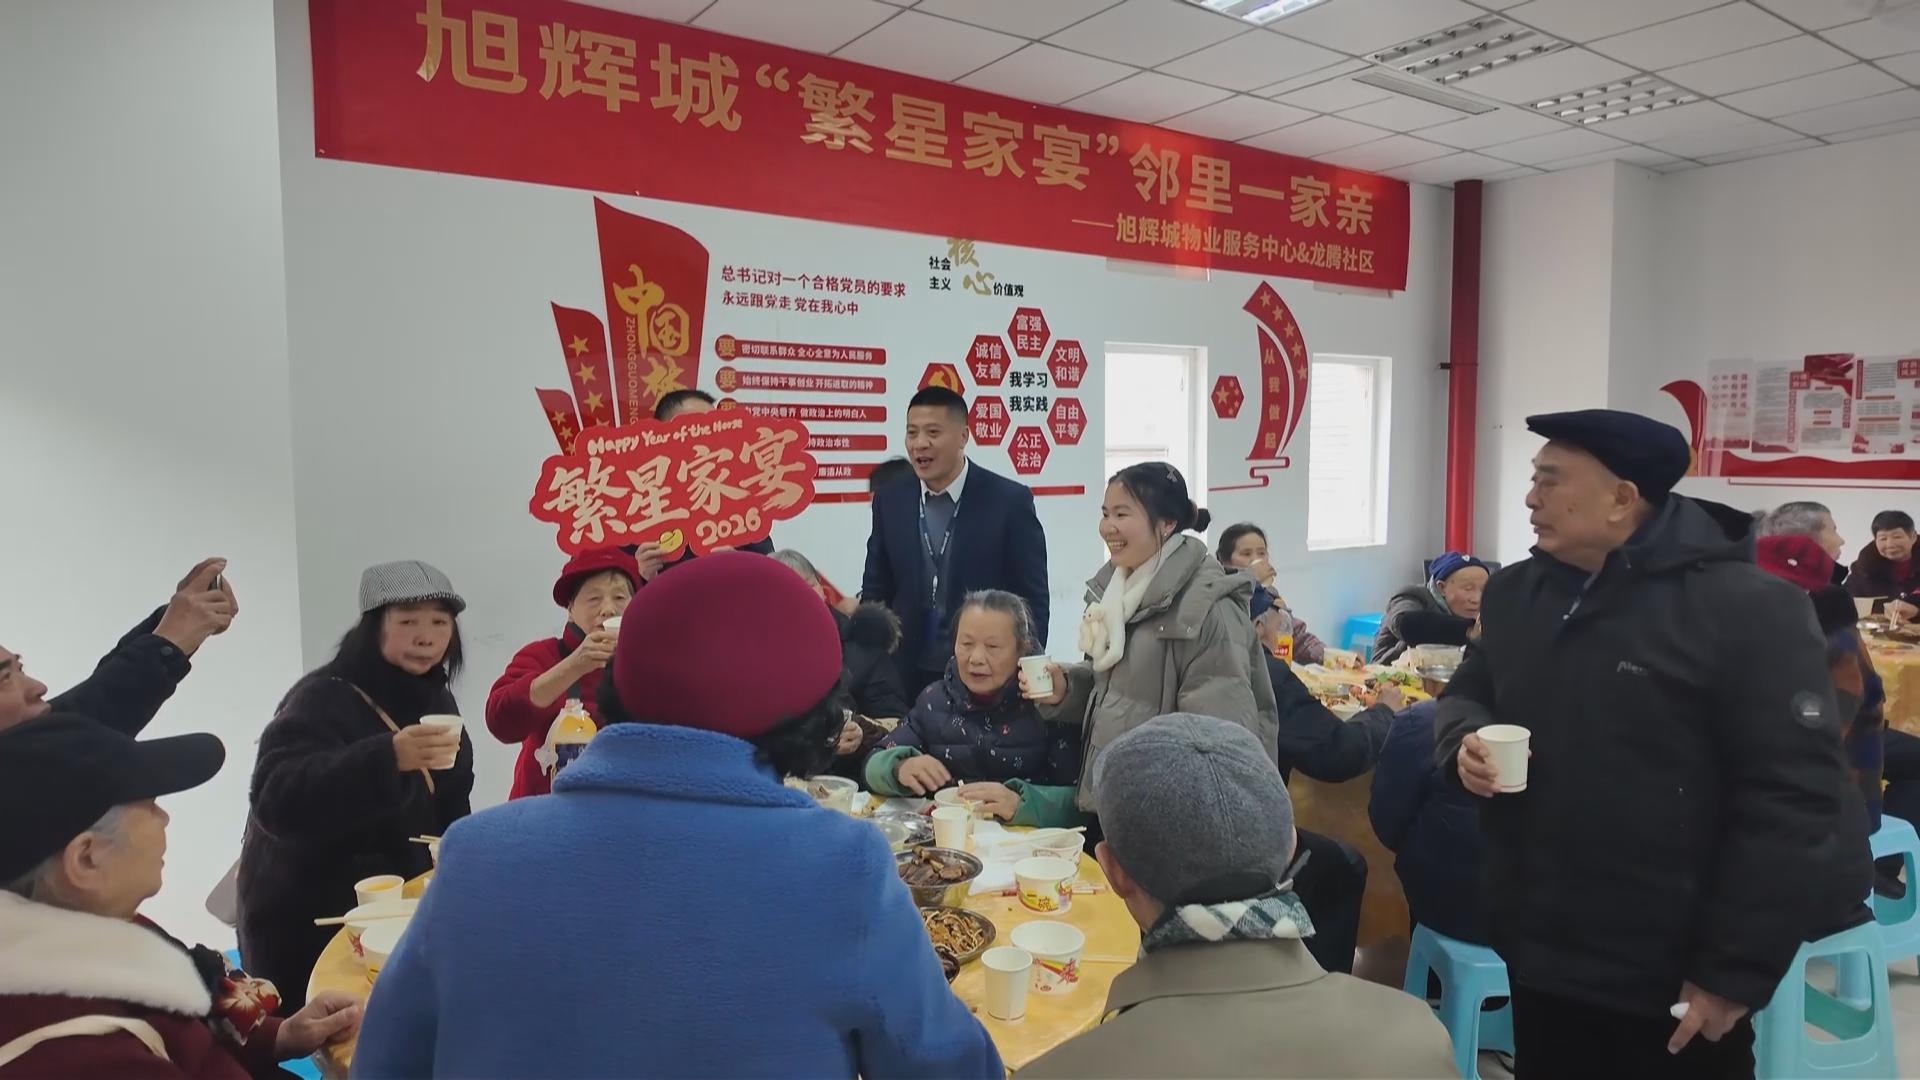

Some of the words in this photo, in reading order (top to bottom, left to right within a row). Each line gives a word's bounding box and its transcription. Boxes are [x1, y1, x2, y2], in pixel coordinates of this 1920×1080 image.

[929, 256, 951, 271] 社会
[721, 265, 906, 298] 总书记对一个合格党员的要求
[929, 276, 951, 291] 主义
[993, 282, 1024, 298] 价值观
[722, 290, 791, 311] 永远跟党走
[795, 297, 859, 316] 党在我心中
[1016, 315, 1042, 332] 富强
[975, 342, 1002, 360] 诚信
[1016, 334, 1042, 351] 民主
[1055, 347, 1080, 363] 文明
[625, 317, 639, 425] ZHONGGUOMENG
[975, 362, 1002, 380] 友善
[1010, 371, 1048, 388] 我学习
[1055, 365, 1080, 382] 和谐
[975, 403, 1002, 420] 爱国
[1010, 395, 1049, 412] 我实践
[1055, 404, 1080, 420] 自由
[642, 429, 672, 447] Year
[672, 425, 688, 443] of
[688, 423, 711, 437] the
[975, 421, 1002, 439] 敬业
[1055, 422, 1080, 439] 平等
[1016, 432, 1042, 449] 公正
[1016, 451, 1042, 468] 法治
[543, 427, 807, 545] 繁星家宴
[695, 507, 762, 546] 2026
